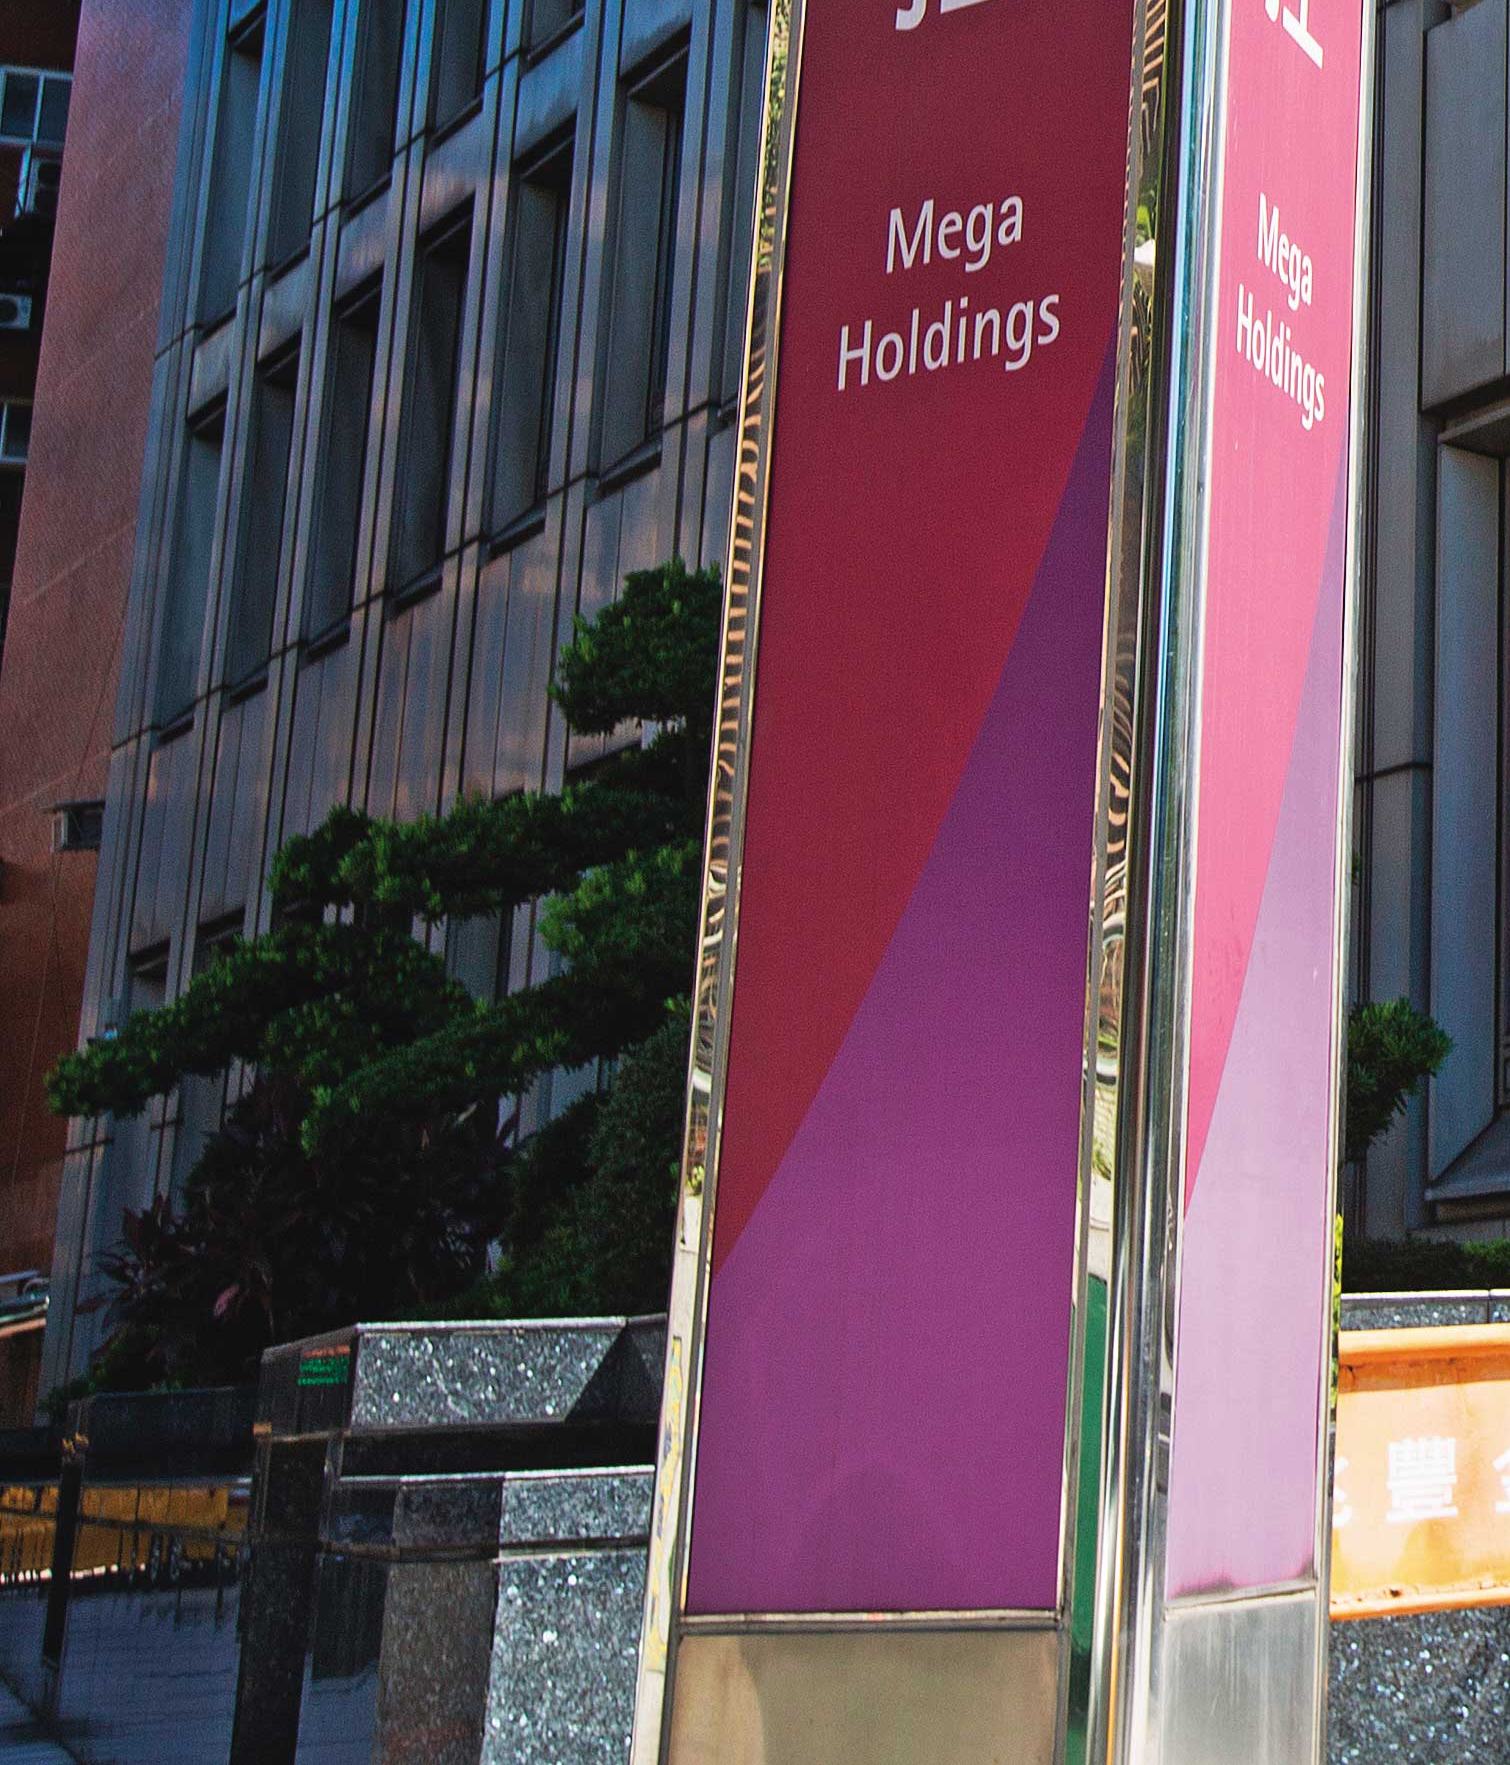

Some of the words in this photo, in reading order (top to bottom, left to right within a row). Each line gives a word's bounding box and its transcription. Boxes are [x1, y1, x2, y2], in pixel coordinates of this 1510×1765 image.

[884, 194, 1024, 274] Mega
[1256, 192, 1313, 311] Mega
[836, 293, 1062, 391] Holdings
[1235, 284, 1326, 431] Holdings
